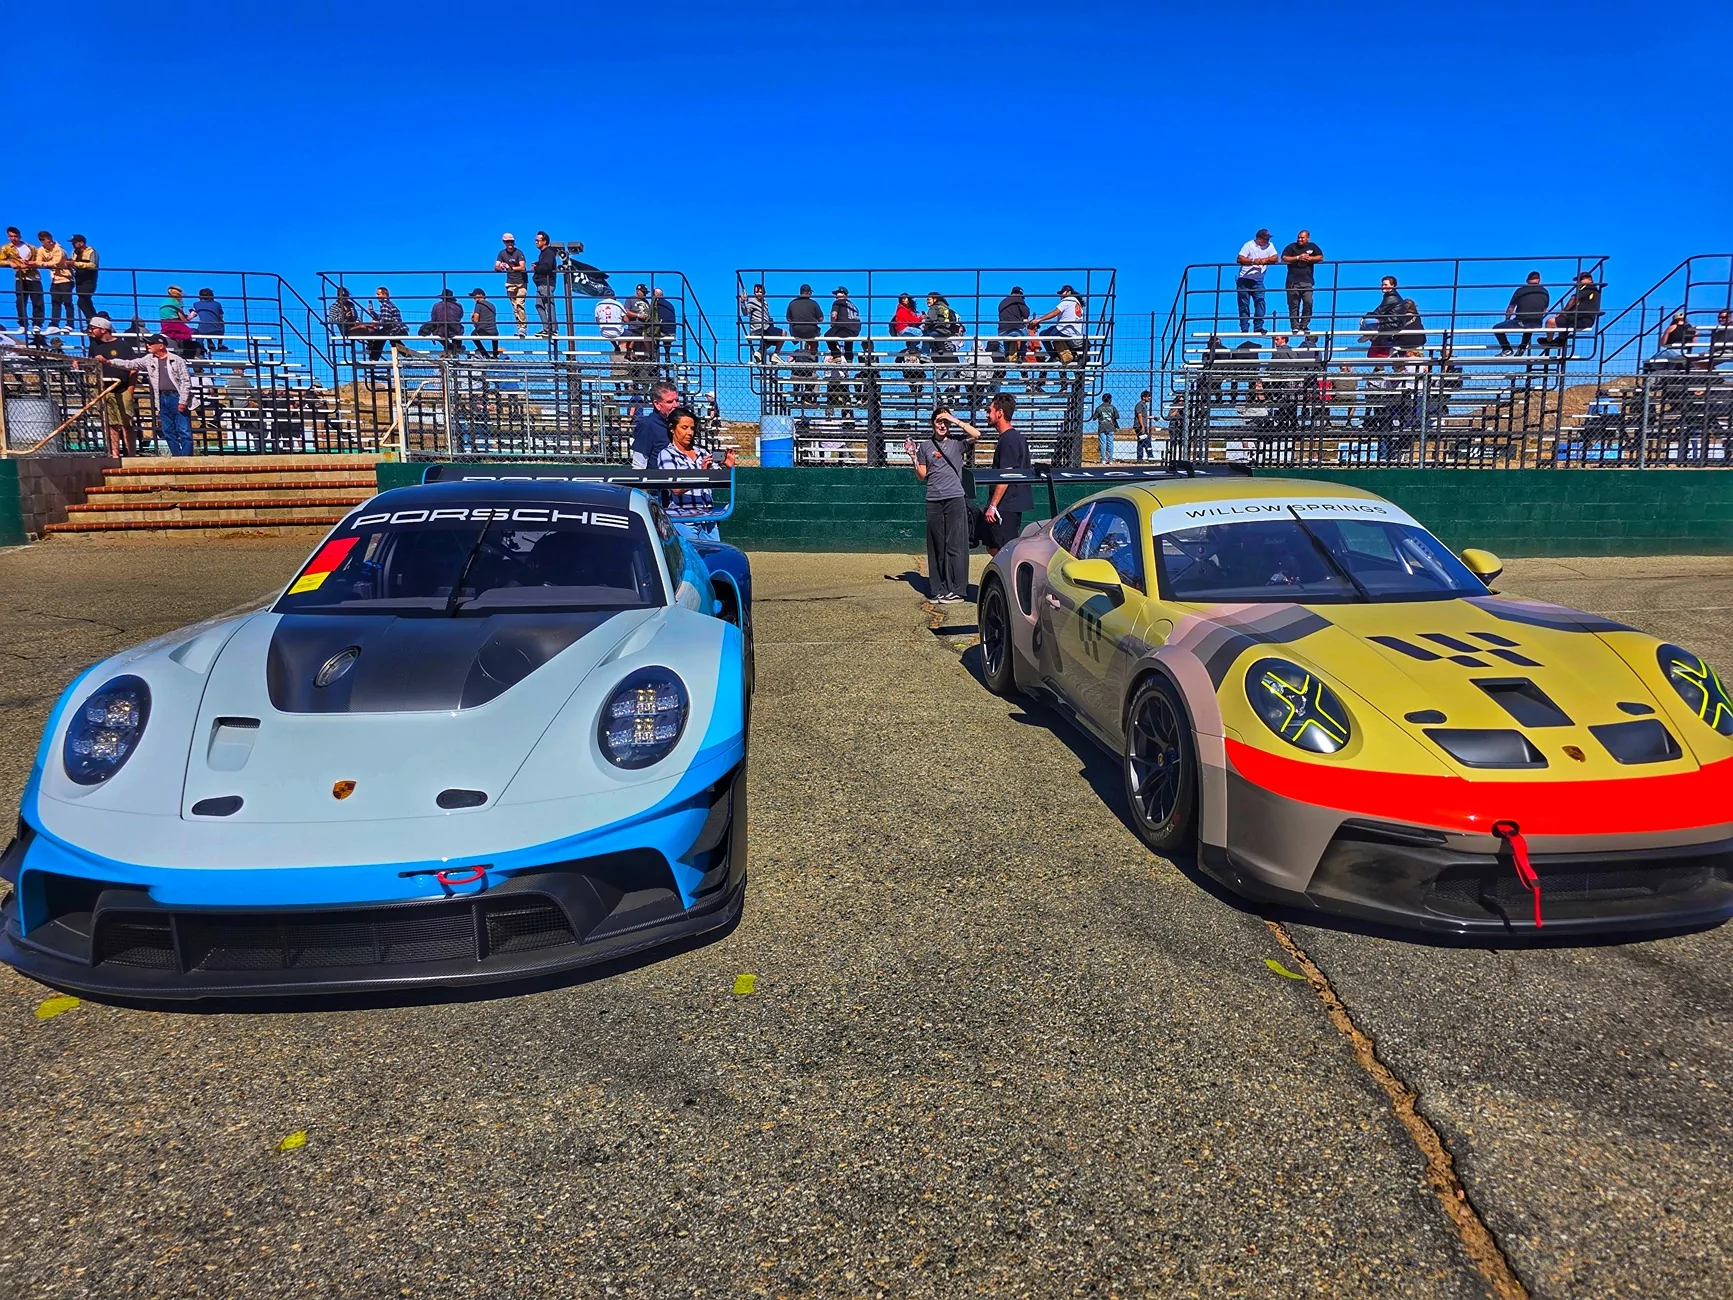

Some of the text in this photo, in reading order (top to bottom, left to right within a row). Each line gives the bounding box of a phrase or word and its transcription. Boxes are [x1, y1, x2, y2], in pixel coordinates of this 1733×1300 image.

[350, 508, 629, 530] PORSCHE
[1185, 503, 1388, 518] WILLOW SPRINGS
